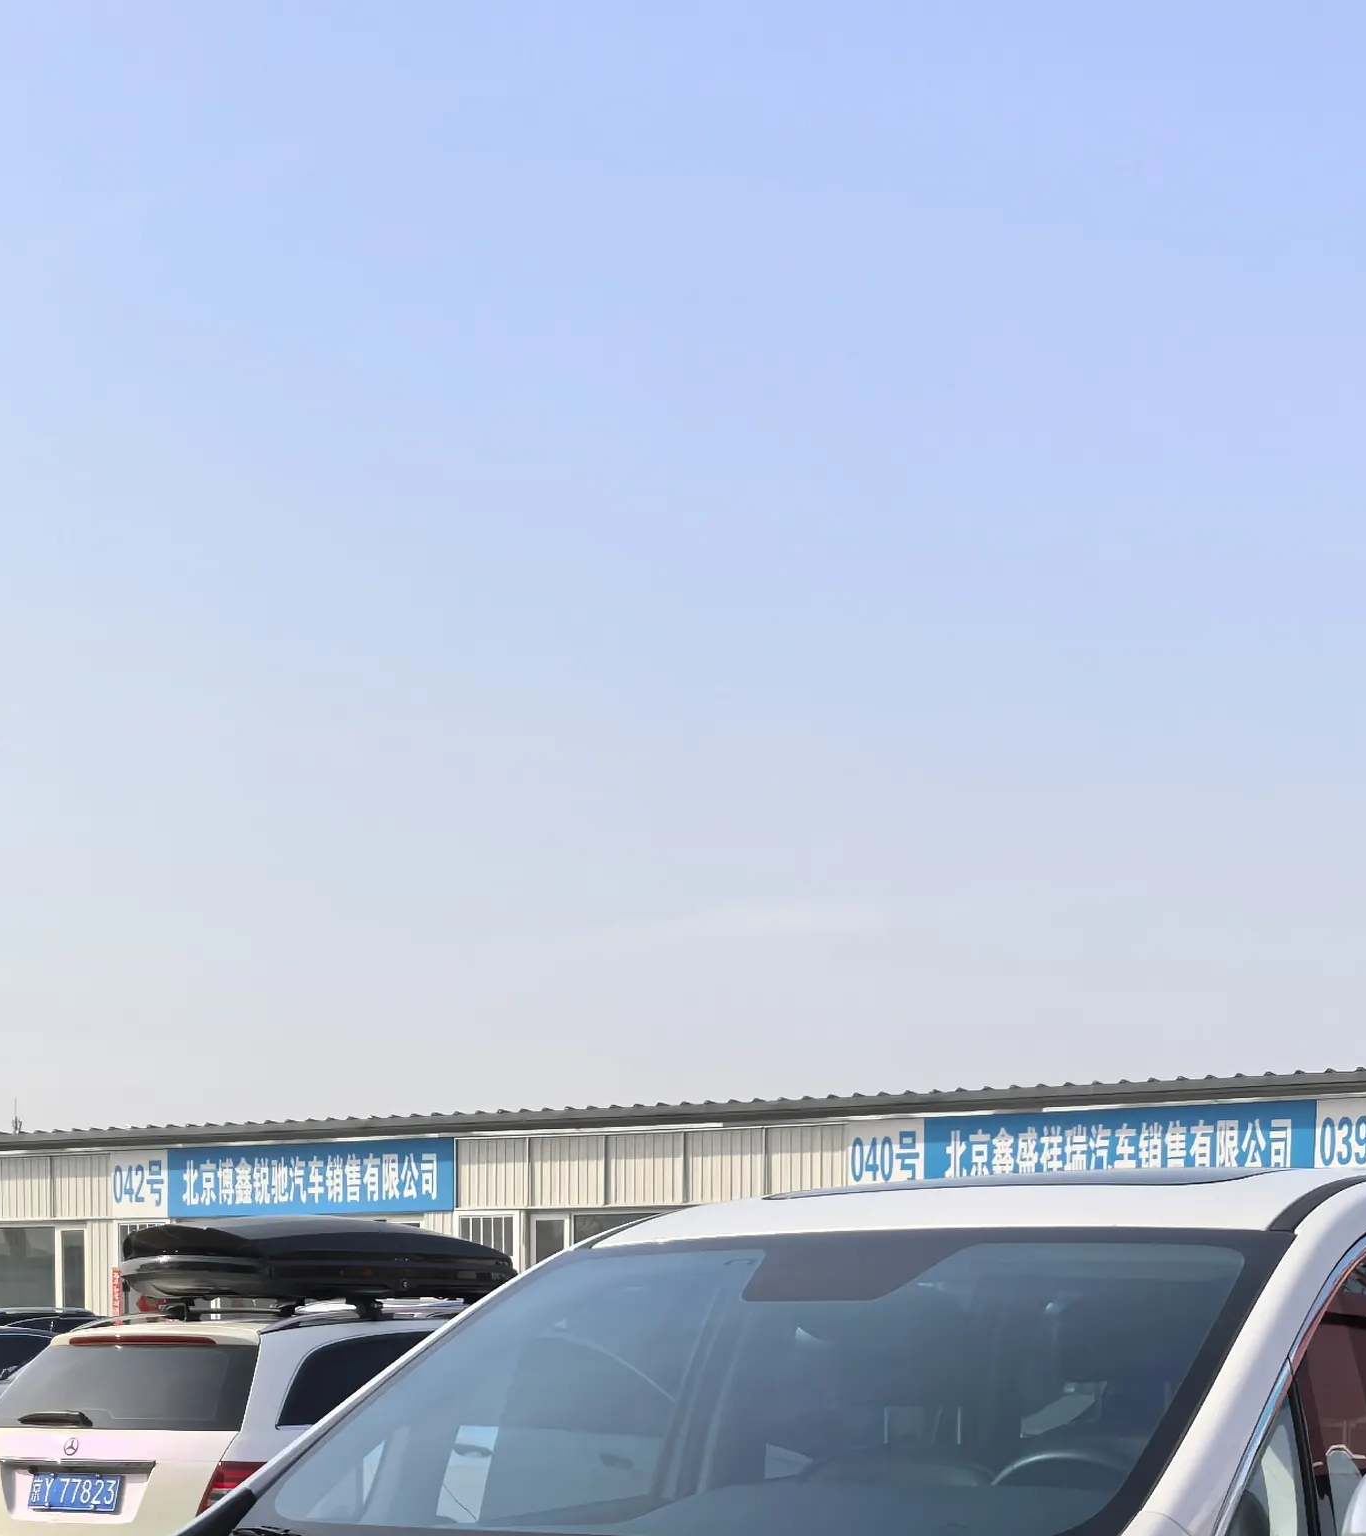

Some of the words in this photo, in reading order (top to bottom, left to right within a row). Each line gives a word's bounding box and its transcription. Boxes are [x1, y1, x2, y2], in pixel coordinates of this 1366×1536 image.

[851, 1130, 920, 1182] 040号
[945, 1118, 1291, 1178] 北京鑫盛祥瑞汽车销售有限公司
[112, 1159, 165, 1207] 042号
[182, 1152, 437, 1207] 北京博鑫锐驰汽车销售有限公司
